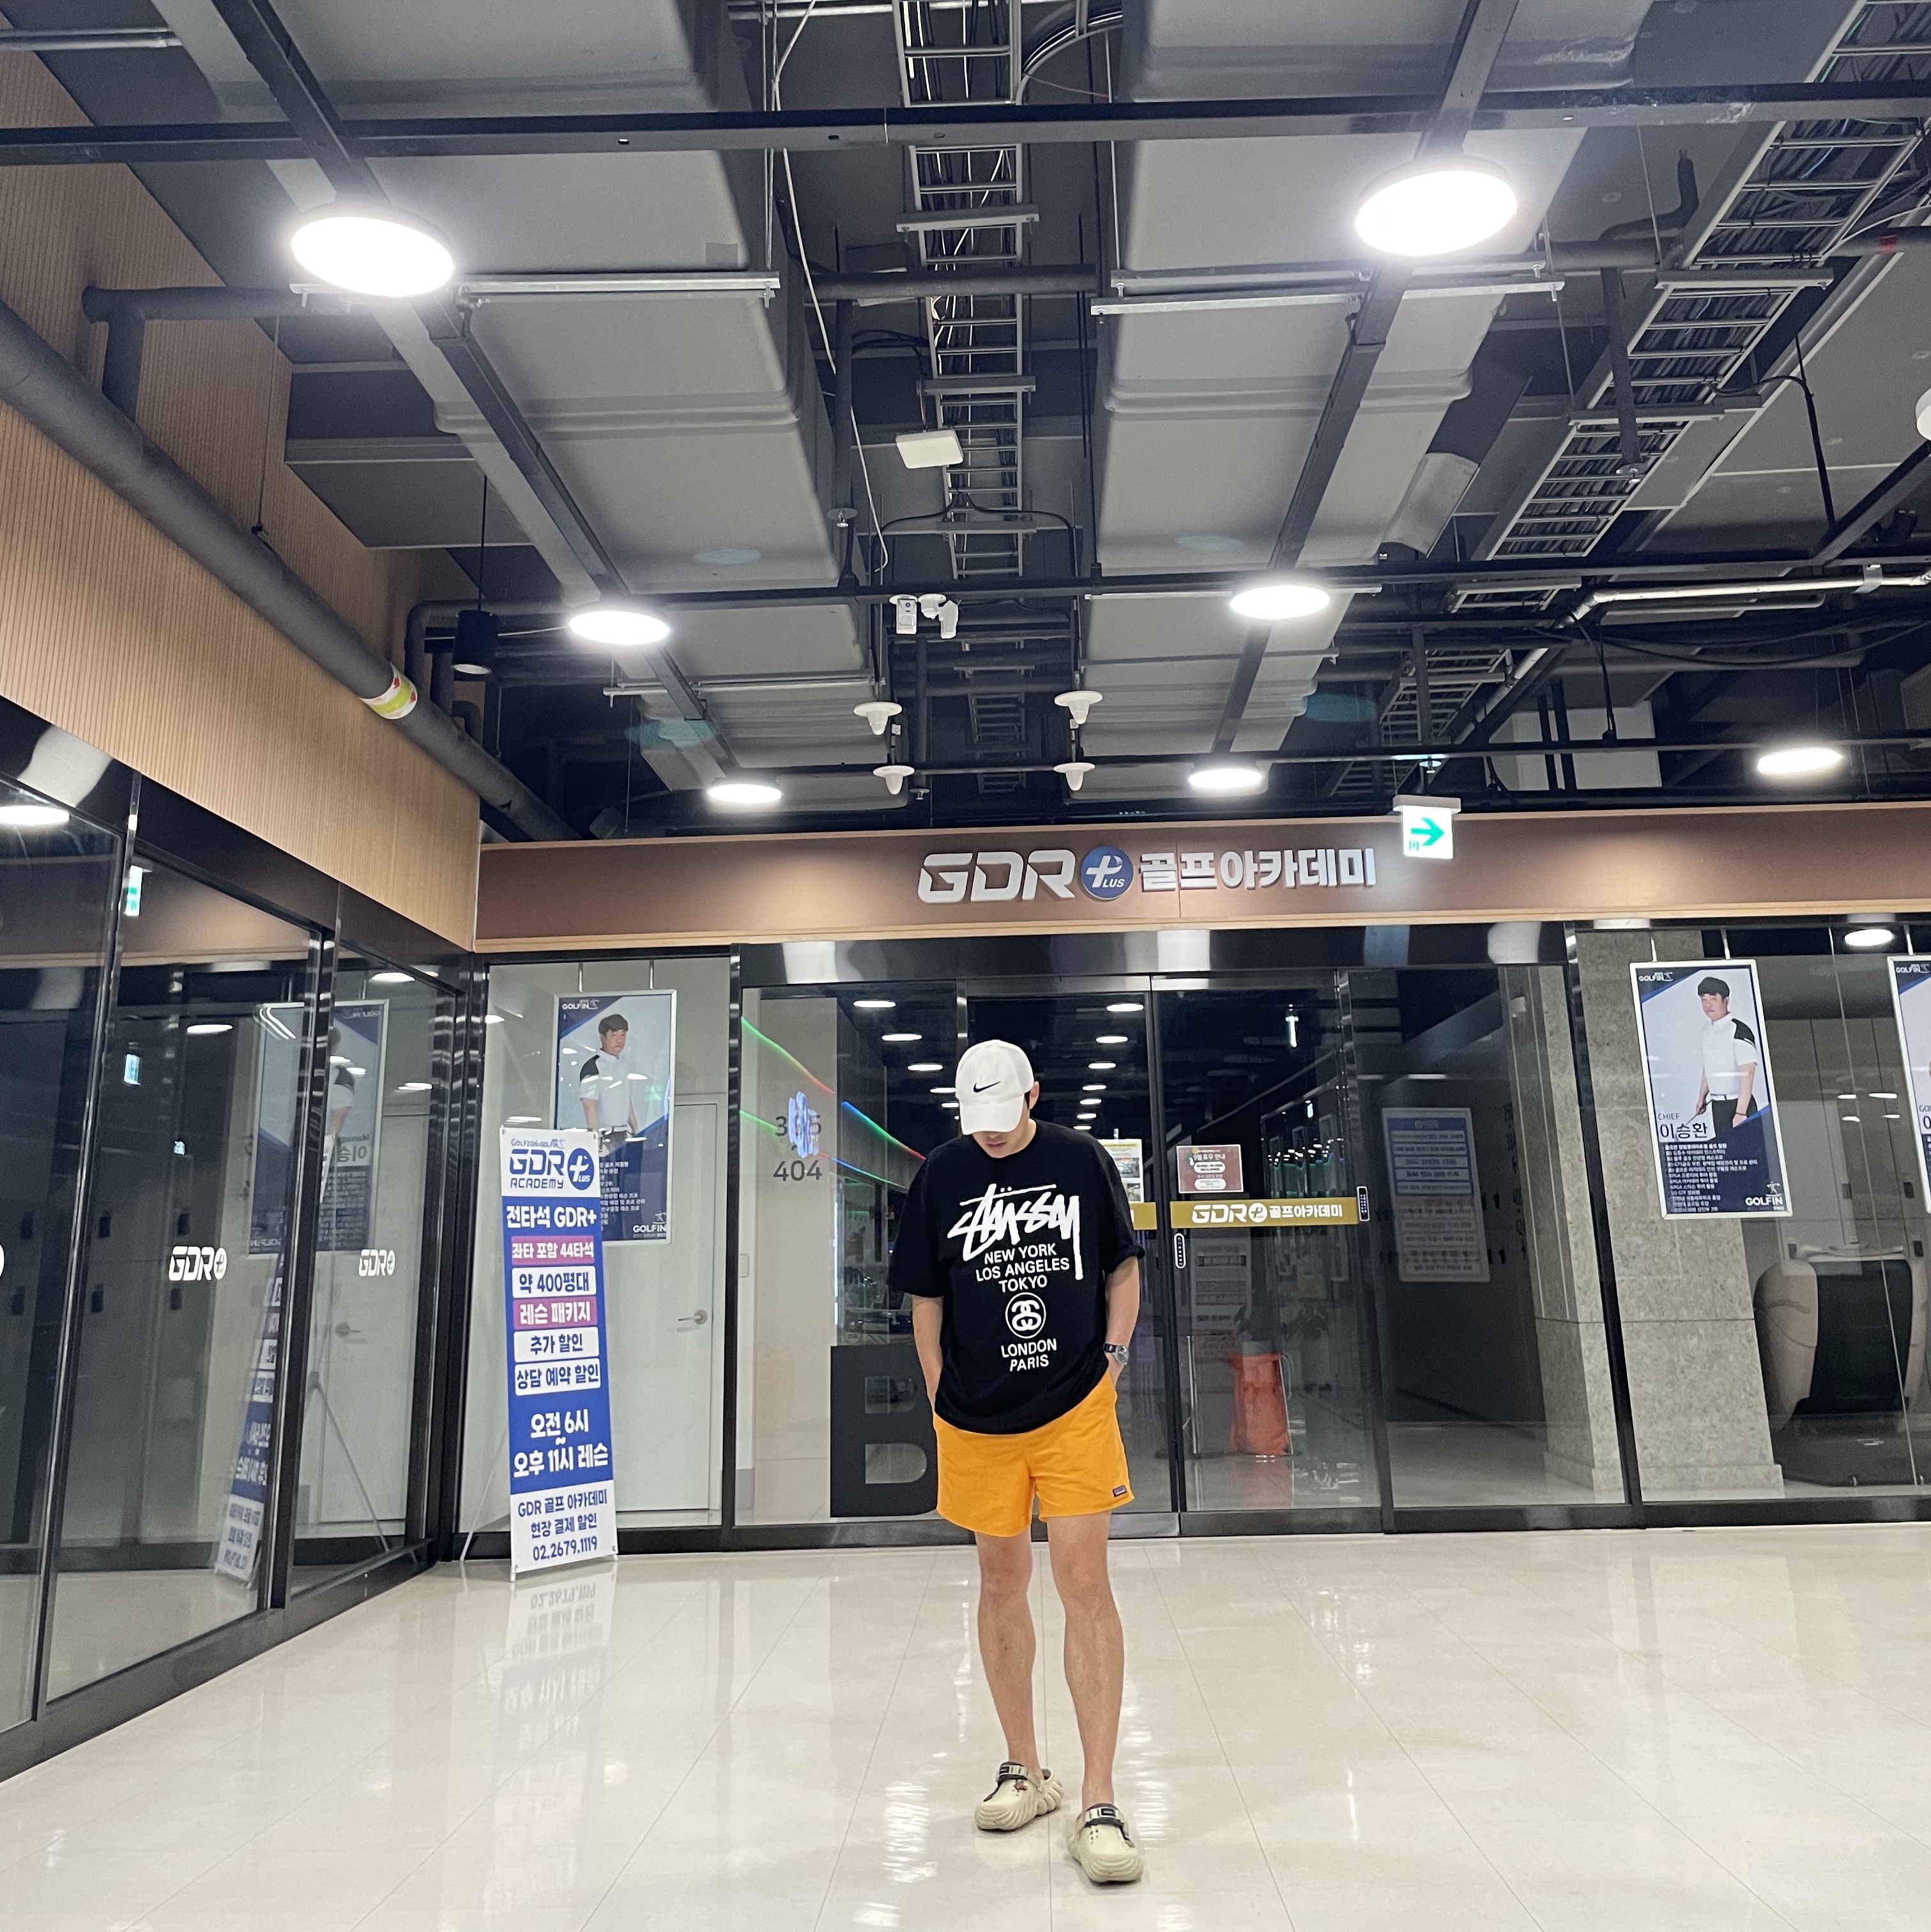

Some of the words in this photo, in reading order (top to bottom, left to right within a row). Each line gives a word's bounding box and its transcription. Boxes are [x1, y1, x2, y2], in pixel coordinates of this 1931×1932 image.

[918, 848, 1076, 903] GDR
[1660, 1123, 1708, 1139] 이승환
[509, 1149, 565, 1176] GDR
[773, 1160, 823, 1181] 404
[510, 1178, 564, 1188] ACADEMY
[1744, 1196, 1783, 1206] GOLFIN
[507, 1206, 551, 1229] 전타석
[554, 1206, 597, 1227] GDR+
[1191, 1204, 1246, 1223] GDR
[632, 1225, 666, 1233] GOLFIN
[512, 1244, 534, 1259] 좌타
[537, 1242, 558, 1259] 포함
[560, 1241, 594, 1257] 44타석
[984, 1248, 1015, 1265] NEW
[1018, 1243, 1057, 1258] YORK
[975, 1266, 1001, 1282] LOS
[1005, 1257, 1070, 1276] ANGELES
[519, 1274, 532, 1293] 약
[537, 1271, 589, 1292] 400평대
[998, 1275, 1048, 1292] TOKYO
[520, 1304, 548, 1325] 레슨
[551, 1301, 591, 1323] 패키지
[530, 1335, 555, 1356] 추가
[558, 1333, 583, 1354] 할인
[1001, 1338, 1057, 1358] LONDON
[1010, 1354, 1049, 1372] PARIS
[517, 1368, 542, 1389] 상담
[546, 1366, 571, 1386] 예약
[574, 1363, 599, 1384] 할인
[530, 1412, 561, 1438] 오전
[565, 1408, 589, 1433] 6시
[514, 1449, 545, 1478] 오후
[547, 1446, 574, 1471] 11시
[577, 1443, 608, 1468] 레슨
[518, 1500, 542, 1517] GDR
[544, 1496, 564, 1513] 골프
[567, 1489, 607, 1510] 아카데미
[531, 1521, 551, 1538] 현장
[554, 1517, 574, 1535] 결제
[577, 1513, 597, 1529] 할인
[533, 1536, 597, 1561] 02.2679.1119
